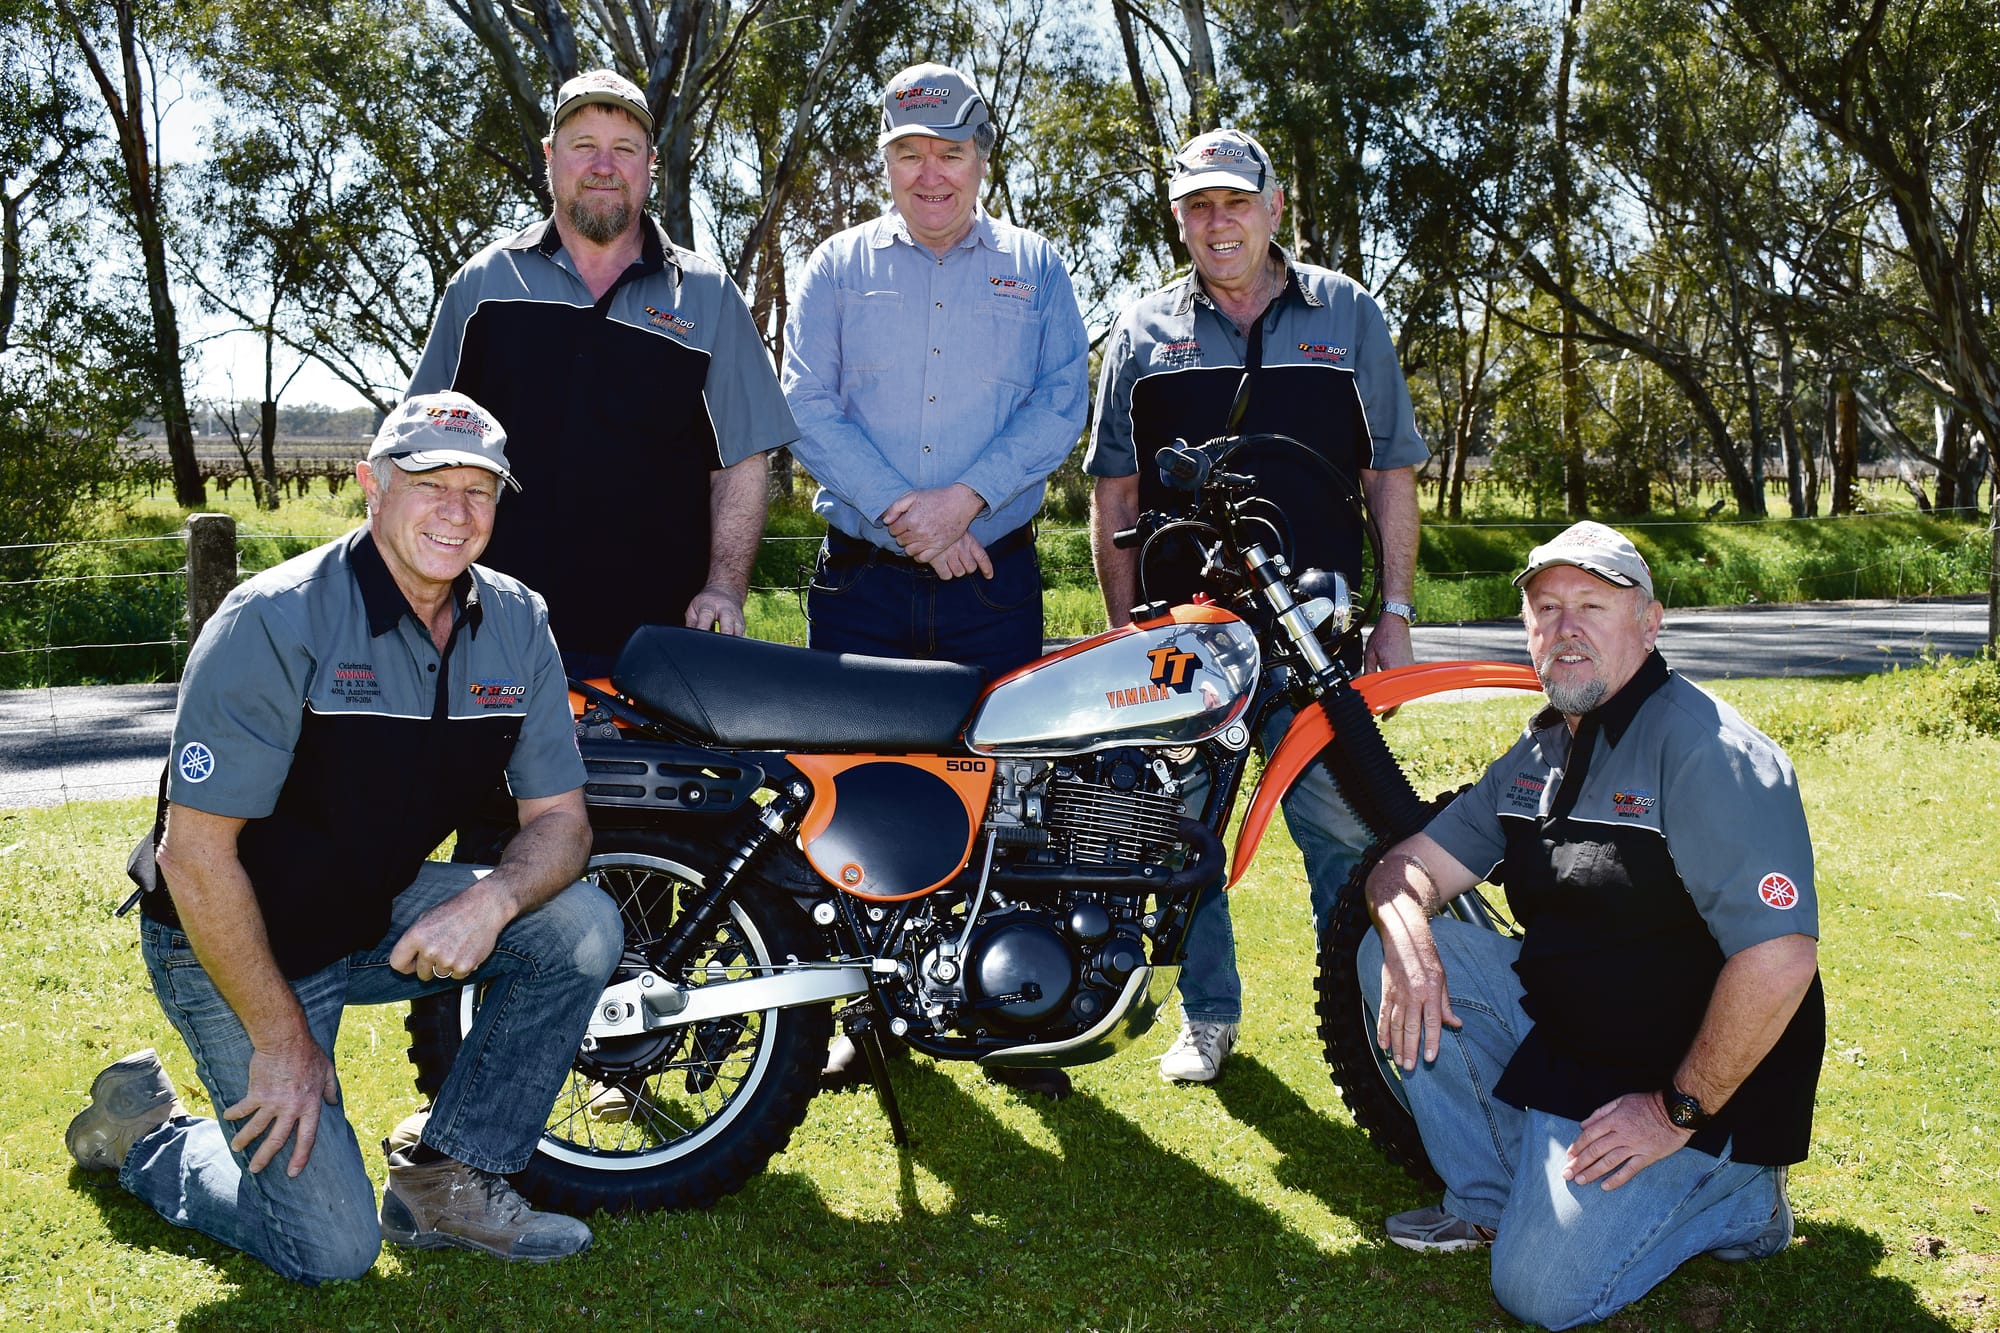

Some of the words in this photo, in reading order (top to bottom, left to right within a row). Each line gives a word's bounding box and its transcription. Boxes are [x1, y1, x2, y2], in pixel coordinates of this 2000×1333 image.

[924, 87, 950, 97] 500
[899, 97, 940, 109] MUSTER
[1217, 147, 1244, 157] 500
[1018, 283, 1037, 293] 500
[674, 316, 695, 330] 500
[1328, 346, 1347, 355] 500
[445, 425, 477, 437] BETHANY
[339, 662, 372, 671] Celebrating
[1147, 646, 1201, 692] TT
[355, 680, 364, 688] XT
[470, 682, 485, 695] TT
[488, 685, 501, 696] XT
[501, 685, 525, 696] 500
[332, 687, 345, 696] 40th
[1106, 682, 1169, 709] YAMAHA
[475, 695, 516, 705] MUSTER
[946, 760, 986, 773] 500
[1525, 788, 1535, 796] XT
[1634, 796, 1656, 808] 500
